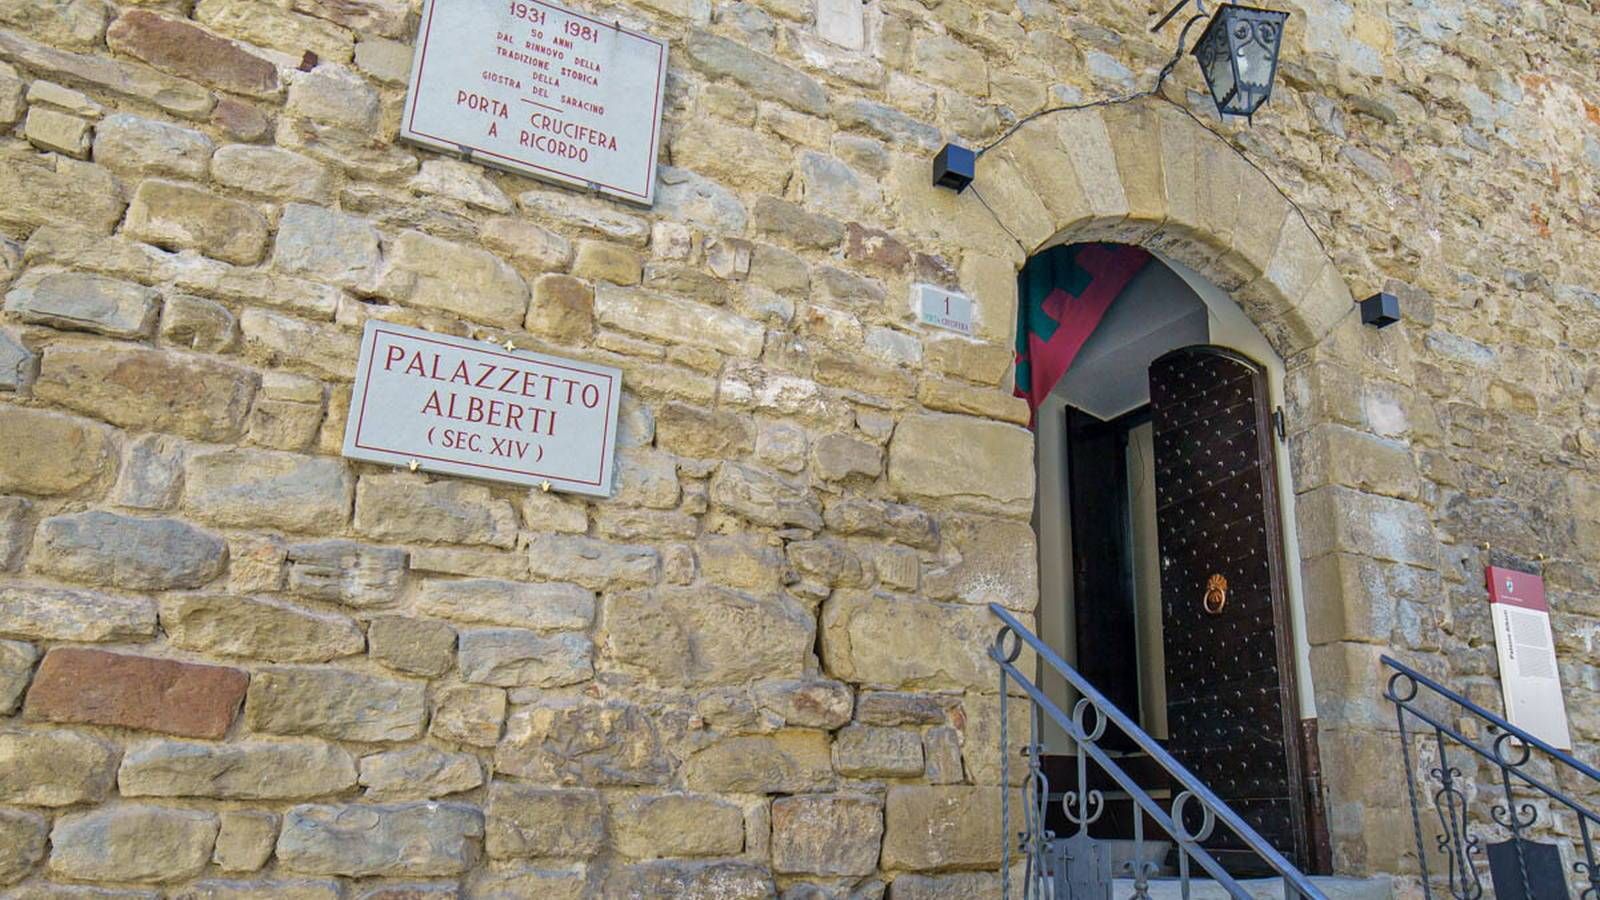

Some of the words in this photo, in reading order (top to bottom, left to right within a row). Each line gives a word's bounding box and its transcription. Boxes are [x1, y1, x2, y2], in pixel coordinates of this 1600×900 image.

[509, 1, 546, 26] 1931
[564, 20, 599, 44] 1981
[530, 28, 544, 40] 50
[552, 36, 574, 49] ANNI
[496, 31, 514, 44] DAL
[525, 40, 565, 60] RINNOVO
[574, 56, 601, 72] DELLA
[496, 46, 551, 71] TRADIZIONE
[560, 66, 599, 87] STORICA
[481, 70, 522, 89] GIOSTRA
[532, 85, 549, 99] DEL
[560, 95, 605, 116] SARACINO
[532, 71, 560, 88] DELLA
[456, 89, 509, 119] PORTA
[530, 112, 618, 151] CRUCIFERA
[488, 121, 498, 138] A
[519, 130, 588, 163] RICORDO
[943, 296, 950, 315] 1
[384, 344, 600, 409] PALAZZETTO
[421, 389, 559, 436] ALBERTI
